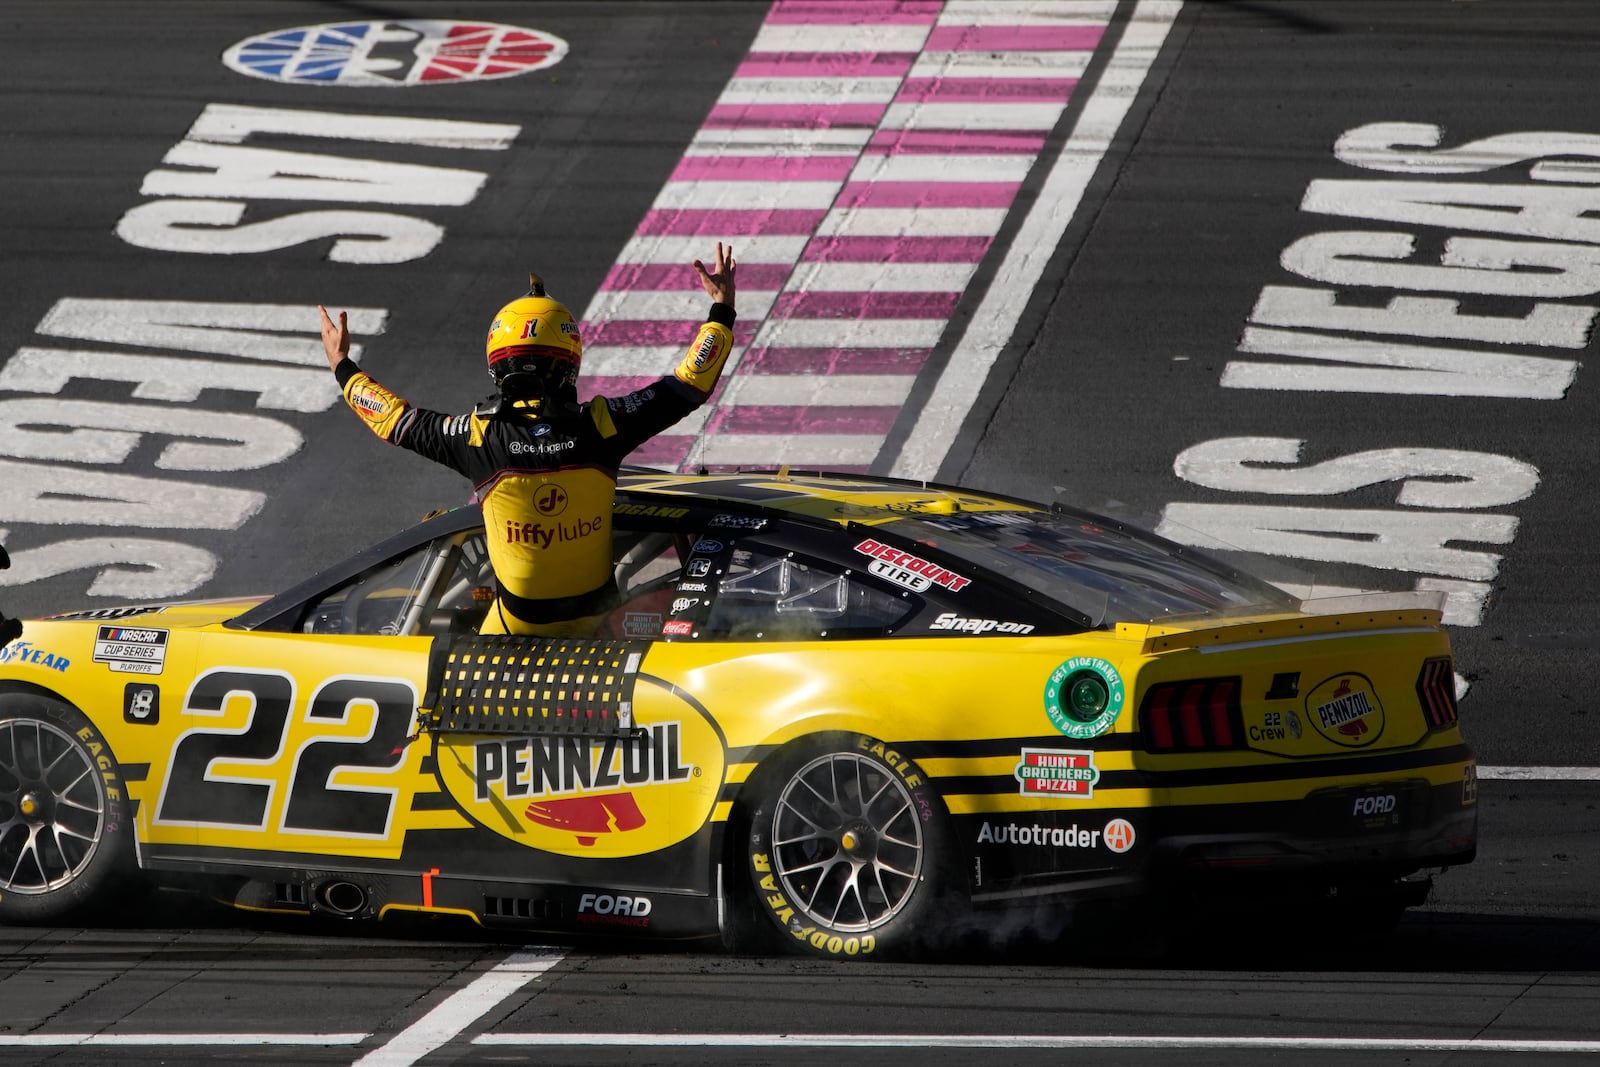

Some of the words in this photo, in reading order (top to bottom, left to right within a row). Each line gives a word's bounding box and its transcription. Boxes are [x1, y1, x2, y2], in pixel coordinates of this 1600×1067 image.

[115, 103, 522, 264] LAS
[1219, 121, 1600, 400] VEGAS
[693, 333, 718, 369] PENNZOIL
[352, 393, 385, 415] PENNZOIL
[0, 297, 389, 600] VEGAS
[509, 440, 575, 456] @joeylogano
[614, 503, 691, 519] OGANO
[506, 520, 555, 550] jiffy
[558, 516, 602, 542] lube
[854, 538, 973, 593] DISCOUNT
[877, 562, 922, 589] TIRE
[676, 582, 708, 592] Mazak
[119, 629, 158, 642] NASCAR
[929, 613, 1035, 635] Snap-on
[104, 644, 124, 655] CUP
[124, 646, 156, 658] SERIES
[120, 663, 152, 673] PLAYOFFS
[1052, 665, 1068, 684] GET
[1068, 657, 1120, 689] BIOETHANOL
[1048, 705, 1064, 723] GET
[1061, 709, 1118, 737] BIOETHANOL
[1264, 712, 1281, 726] 22
[1317, 690, 1374, 731] PENNZOIL
[1249, 726, 1285, 741] Crew
[76, 726, 120, 801] EAGLE
[152, 665, 420, 841] 22
[474, 720, 694, 803] PENNZOIL
[858, 736, 923, 790] EAGLE
[1037, 755, 1077, 768] HUNT
[1022, 768, 1092, 780] BROTHERS
[1036, 779, 1077, 791] PIZZA
[1353, 795, 1396, 816] FORD
[976, 821, 1100, 849] Autotrader
[577, 893, 653, 917] FORD
[752, 853, 876, 955] GOODYEAR
